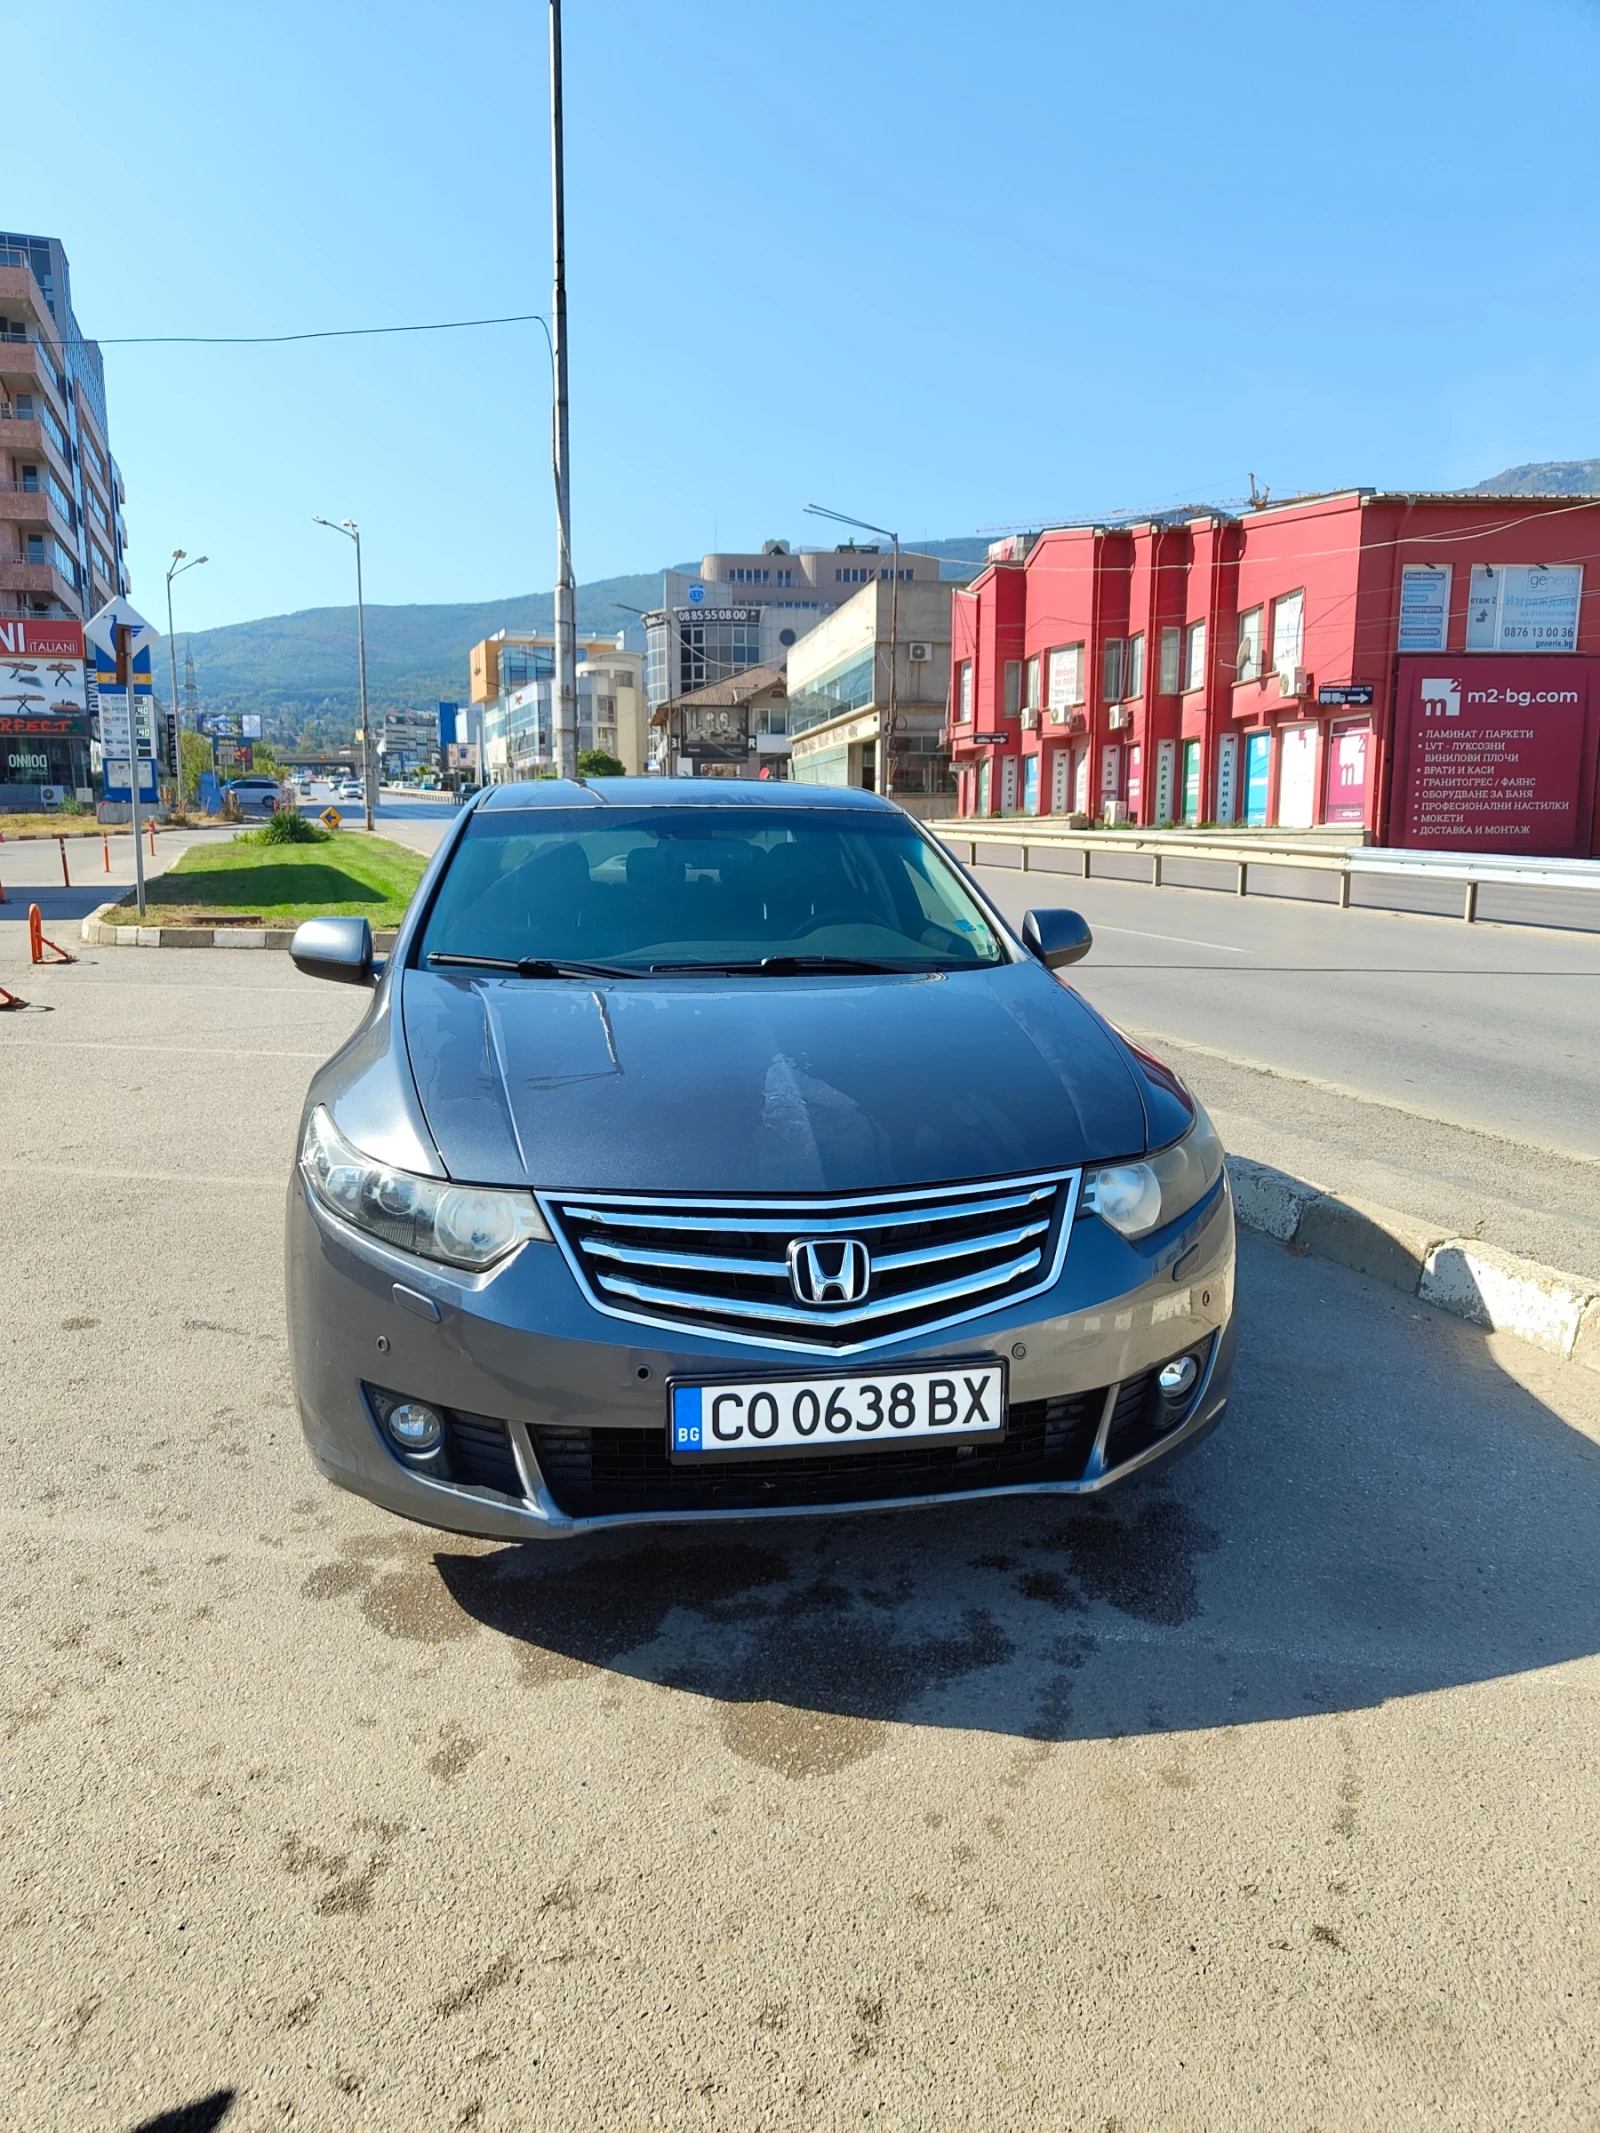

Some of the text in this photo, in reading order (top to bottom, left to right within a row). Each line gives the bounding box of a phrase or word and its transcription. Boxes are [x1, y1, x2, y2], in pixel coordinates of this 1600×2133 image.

[1530, 574, 1577, 589] generix
[1492, 596, 1497, 604] 2
[1506, 595, 1576, 608] Изграждане
[1504, 627, 1573, 637] 0876 13 00 36
[29, 641, 75, 653] ITALIANI
[1536, 640, 1573, 648] generix.bg
[1467, 688, 1578, 706] m2-bg.com
[1425, 730, 1477, 738] ЛАМИНАТ
[1485, 729, 1534, 738] ПАРКЕТИ
[1425, 742, 1443, 750] LVT
[1452, 742, 1505, 750] ЛУКСОЗНИ
[1424, 754, 1519, 762] ВИНИЛОВИ ПЛОЧИ
[1423, 766, 1495, 774] ВРАТИ И КАСИ
[1221, 751, 1230, 817] ЛАМИНАТ
[1423, 778, 1493, 786] ГРАНИТОГРЕС
[1501, 777, 1536, 786] ФАЯНС
[1160, 756, 1168, 818] ПАРКЕТИ
[1422, 790, 1488, 799] ОБОРУДВАНЕ
[1490, 790, 1503, 798] ЗА
[1421, 802, 1569, 810] ПРОФЕСИОНАЛНИ НАСТИЛКИ
[1420, 814, 1464, 822] МОКЕТИ
[1419, 825, 1530, 836] ДОСТАВКА И МОНТАЖ
[711, 1375, 991, 1441] CO 0638 BX
[678, 1427, 699, 1443] BG
